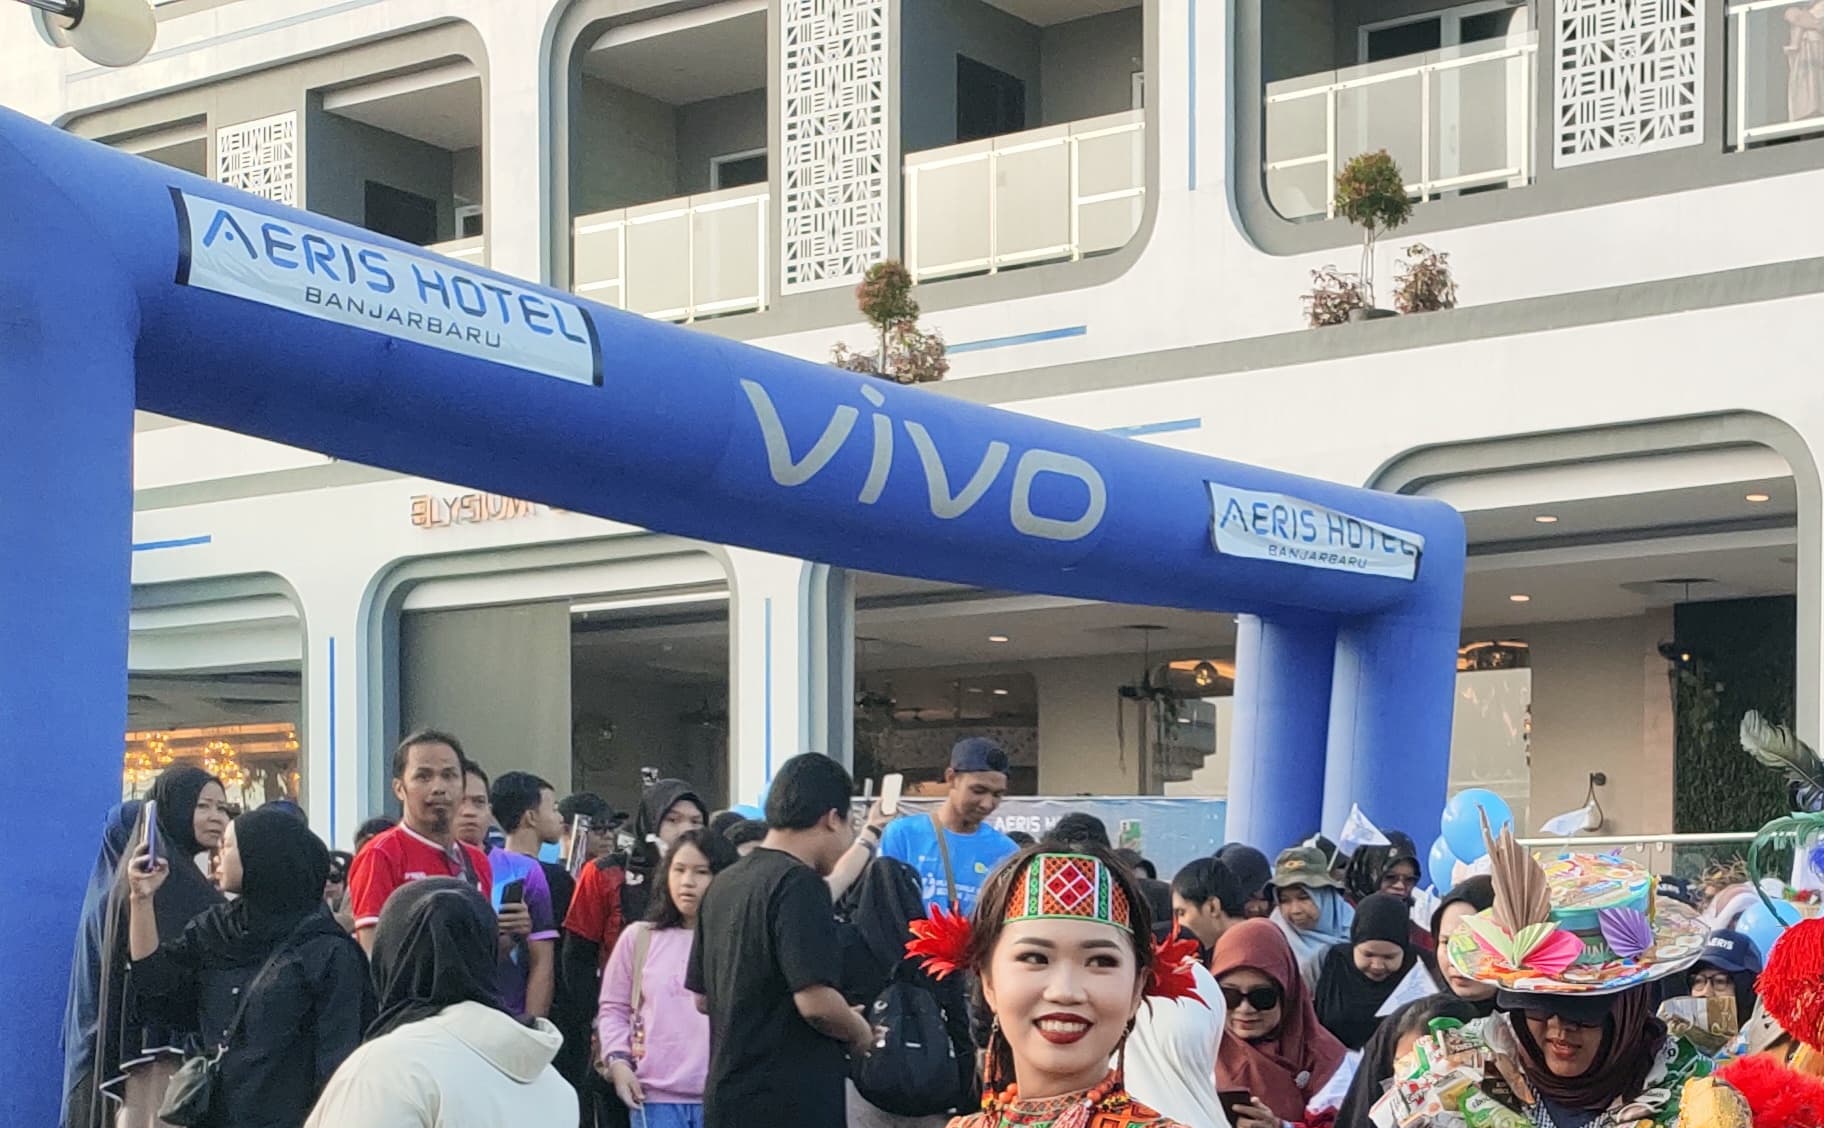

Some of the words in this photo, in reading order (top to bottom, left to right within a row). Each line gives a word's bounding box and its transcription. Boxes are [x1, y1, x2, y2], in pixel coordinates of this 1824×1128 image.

[203, 208, 394, 293] AERIS
[411, 263, 588, 344] HOTEL
[304, 286, 501, 348] BANJARBARU
[739, 378, 1107, 541] vivo
[1219, 498, 1318, 542] AERIS
[1268, 544, 1368, 569] BANJARBARU
